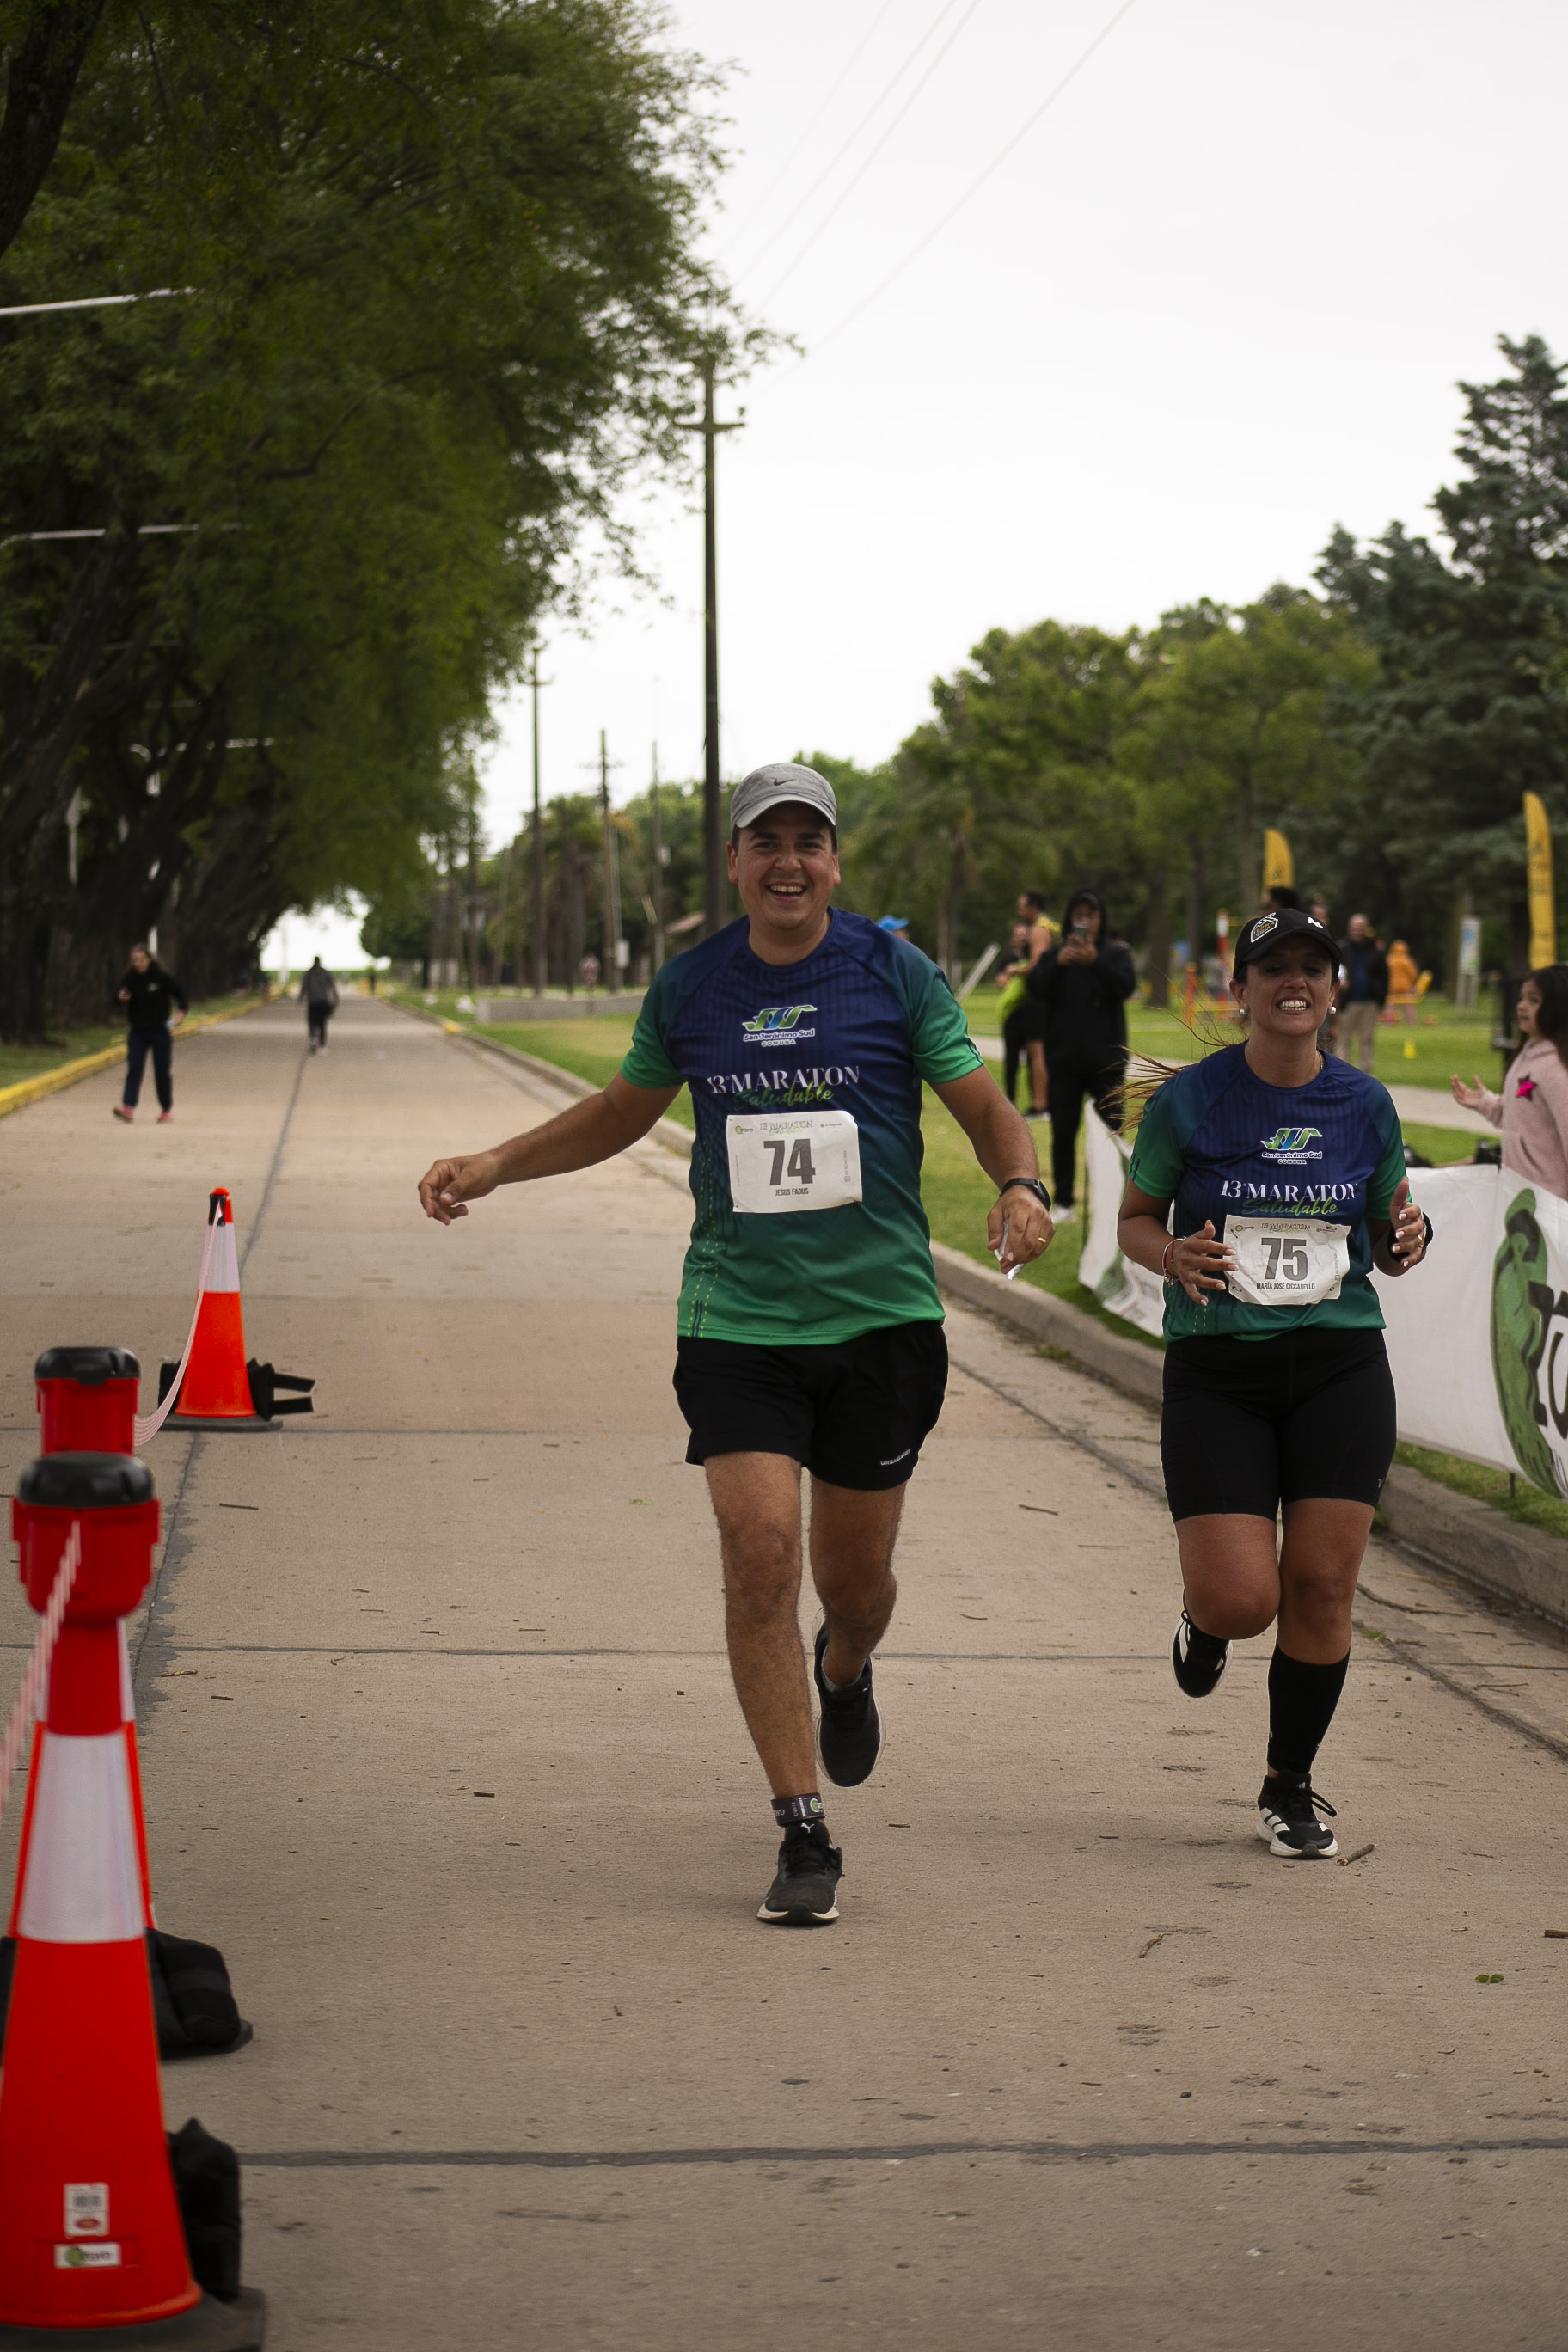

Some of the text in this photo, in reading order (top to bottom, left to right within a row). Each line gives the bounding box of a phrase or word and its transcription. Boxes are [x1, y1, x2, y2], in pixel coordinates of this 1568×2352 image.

[799, 1029, 815, 1038] Sud
[734, 1081, 834, 1111] Saludable
[763, 1138, 816, 1186] 74
[1241, 1197, 1338, 1216] Saludable
[1261, 1237, 1308, 1281] 75
